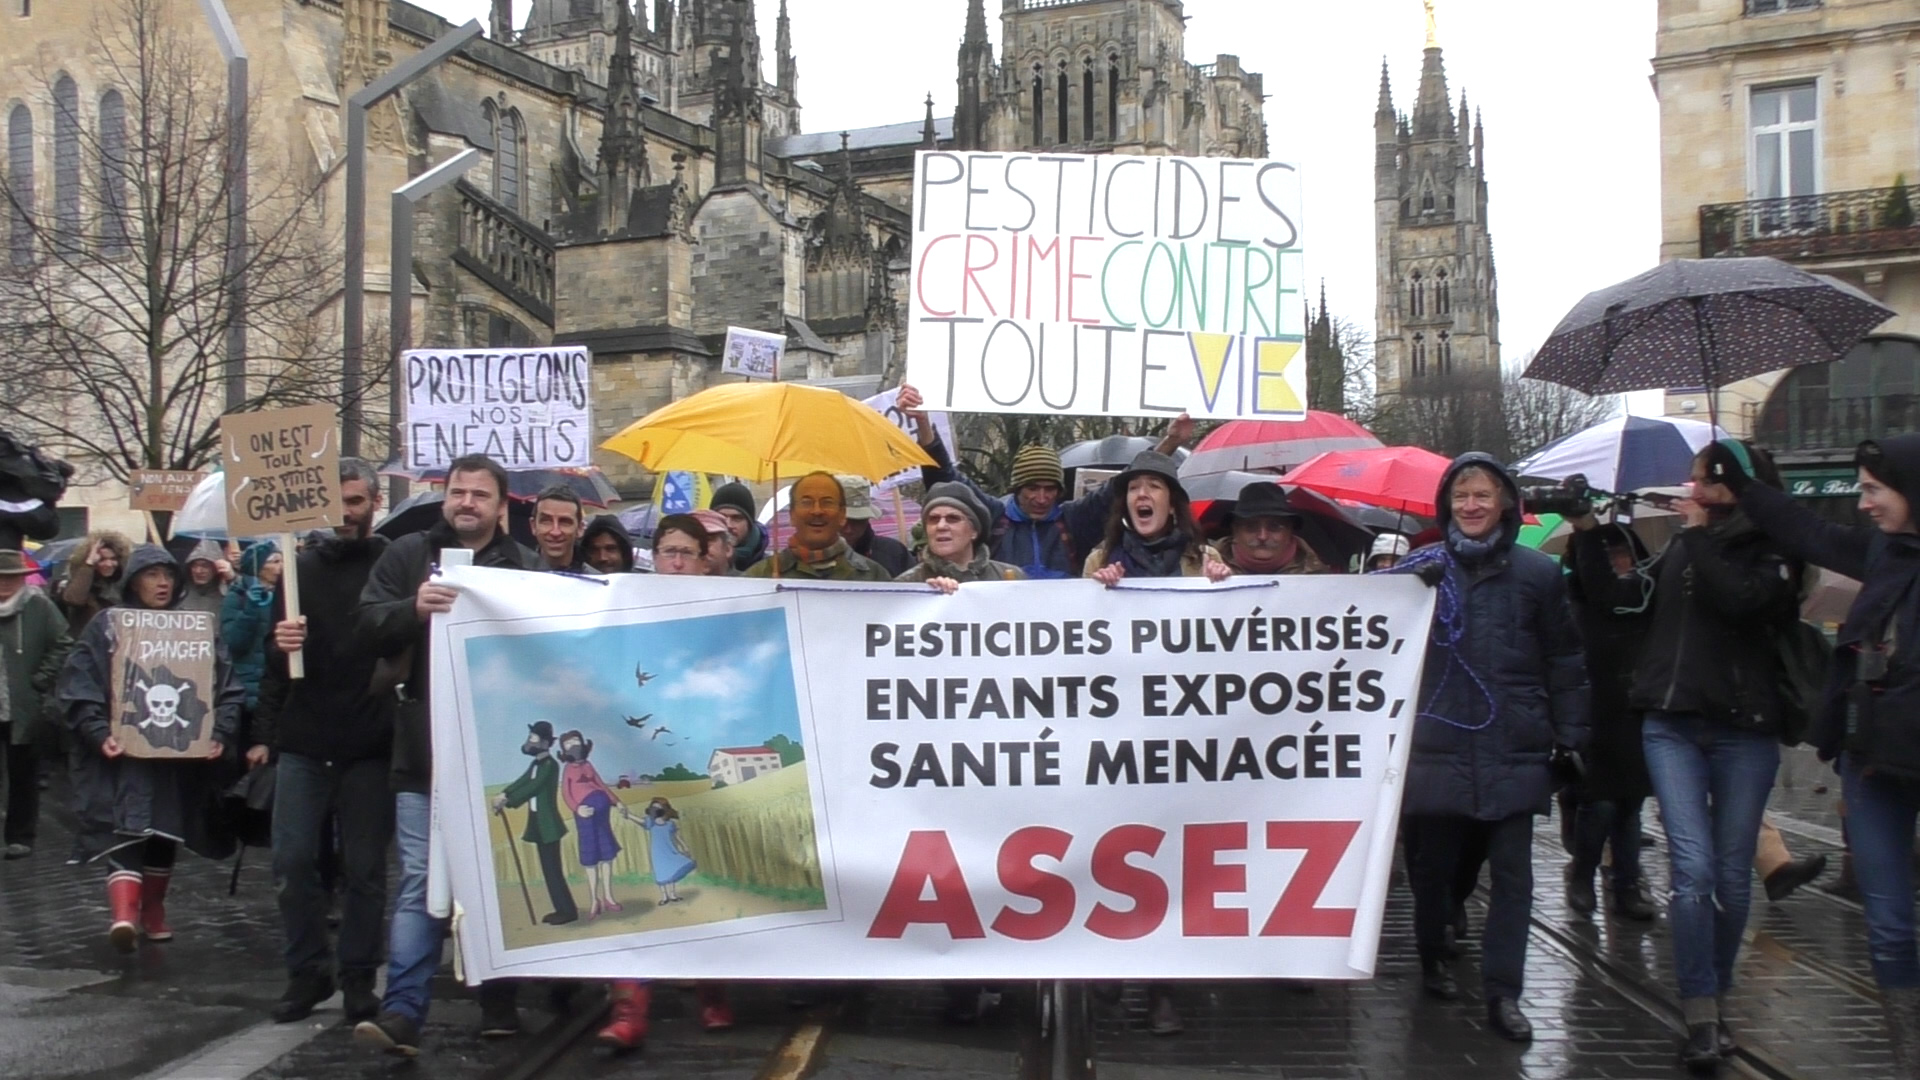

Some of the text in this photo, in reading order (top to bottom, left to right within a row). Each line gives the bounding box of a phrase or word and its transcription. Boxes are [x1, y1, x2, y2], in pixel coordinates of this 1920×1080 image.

[919, 152, 1298, 249] PESTICIDES
[917, 231, 1304, 339] CRIME CONTRE
[407, 352, 587, 411] PROTEGEONS
[920, 317, 1305, 416] TOUTE VIE
[250, 424, 313, 452] ON EST
[470, 406, 523, 425] NOS
[260, 449, 303, 469] TOUS
[411, 419, 579, 468] ENFANTS
[166, 473, 194, 483] AUX
[250, 476, 276, 491] DES
[1792, 480, 1816, 495] Le
[121, 611, 207, 630] GIRONDE
[865, 605, 1405, 657] PESTICIDES PULVÉRISÉS,
[139, 640, 211, 661] DANGER
[866, 658, 1406, 721] ENFANTS EXPOSÉS,
[869, 720, 1362, 788] SANTÉ MENACÉE
[865, 820, 1363, 941] ASSEZ
